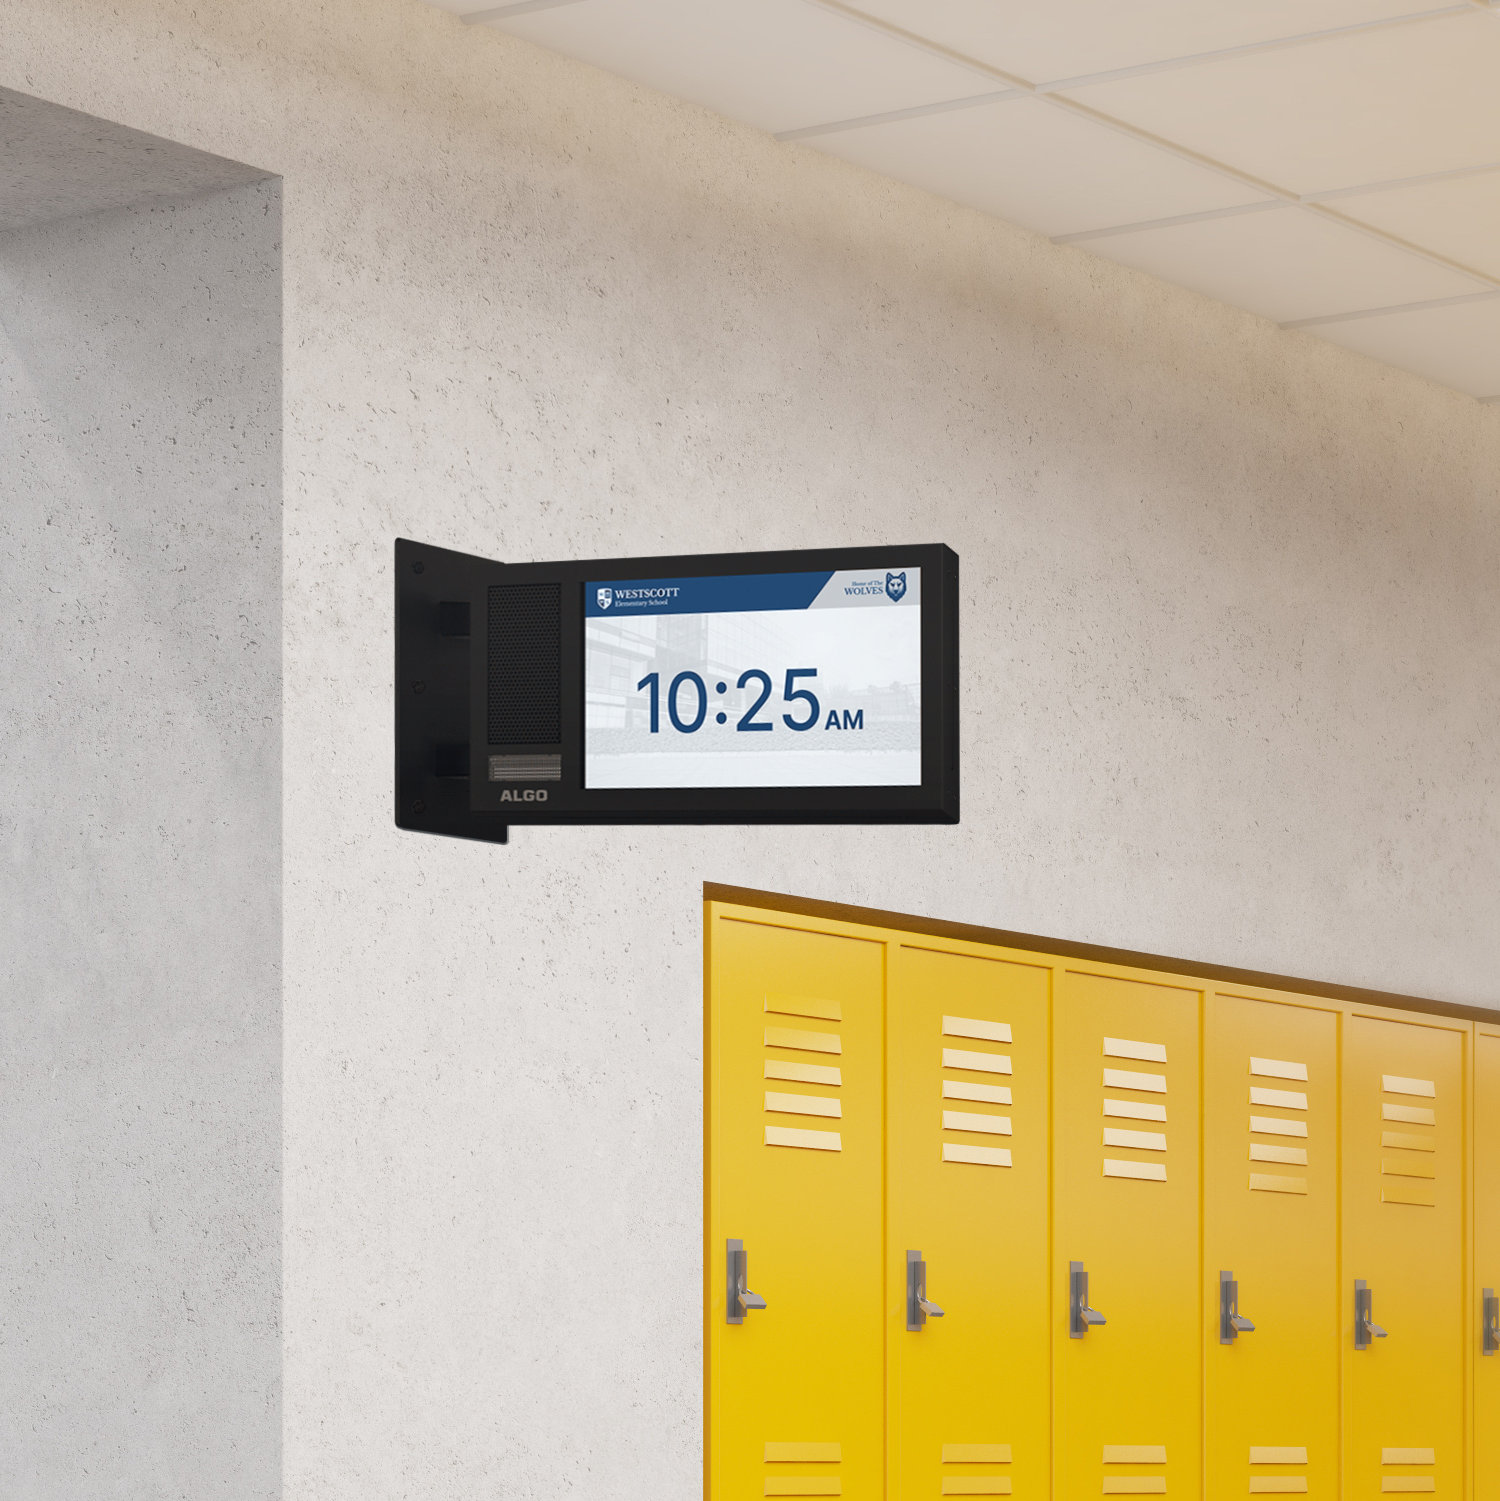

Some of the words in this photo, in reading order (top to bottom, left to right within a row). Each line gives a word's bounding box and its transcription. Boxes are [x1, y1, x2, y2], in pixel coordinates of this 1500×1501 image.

[615, 588, 680, 599] WESTSCOTT
[844, 586, 884, 595] WOLVES
[636, 668, 821, 735] 10:25
[824, 709, 864, 730] AM
[500, 789, 548, 802] ALGO
